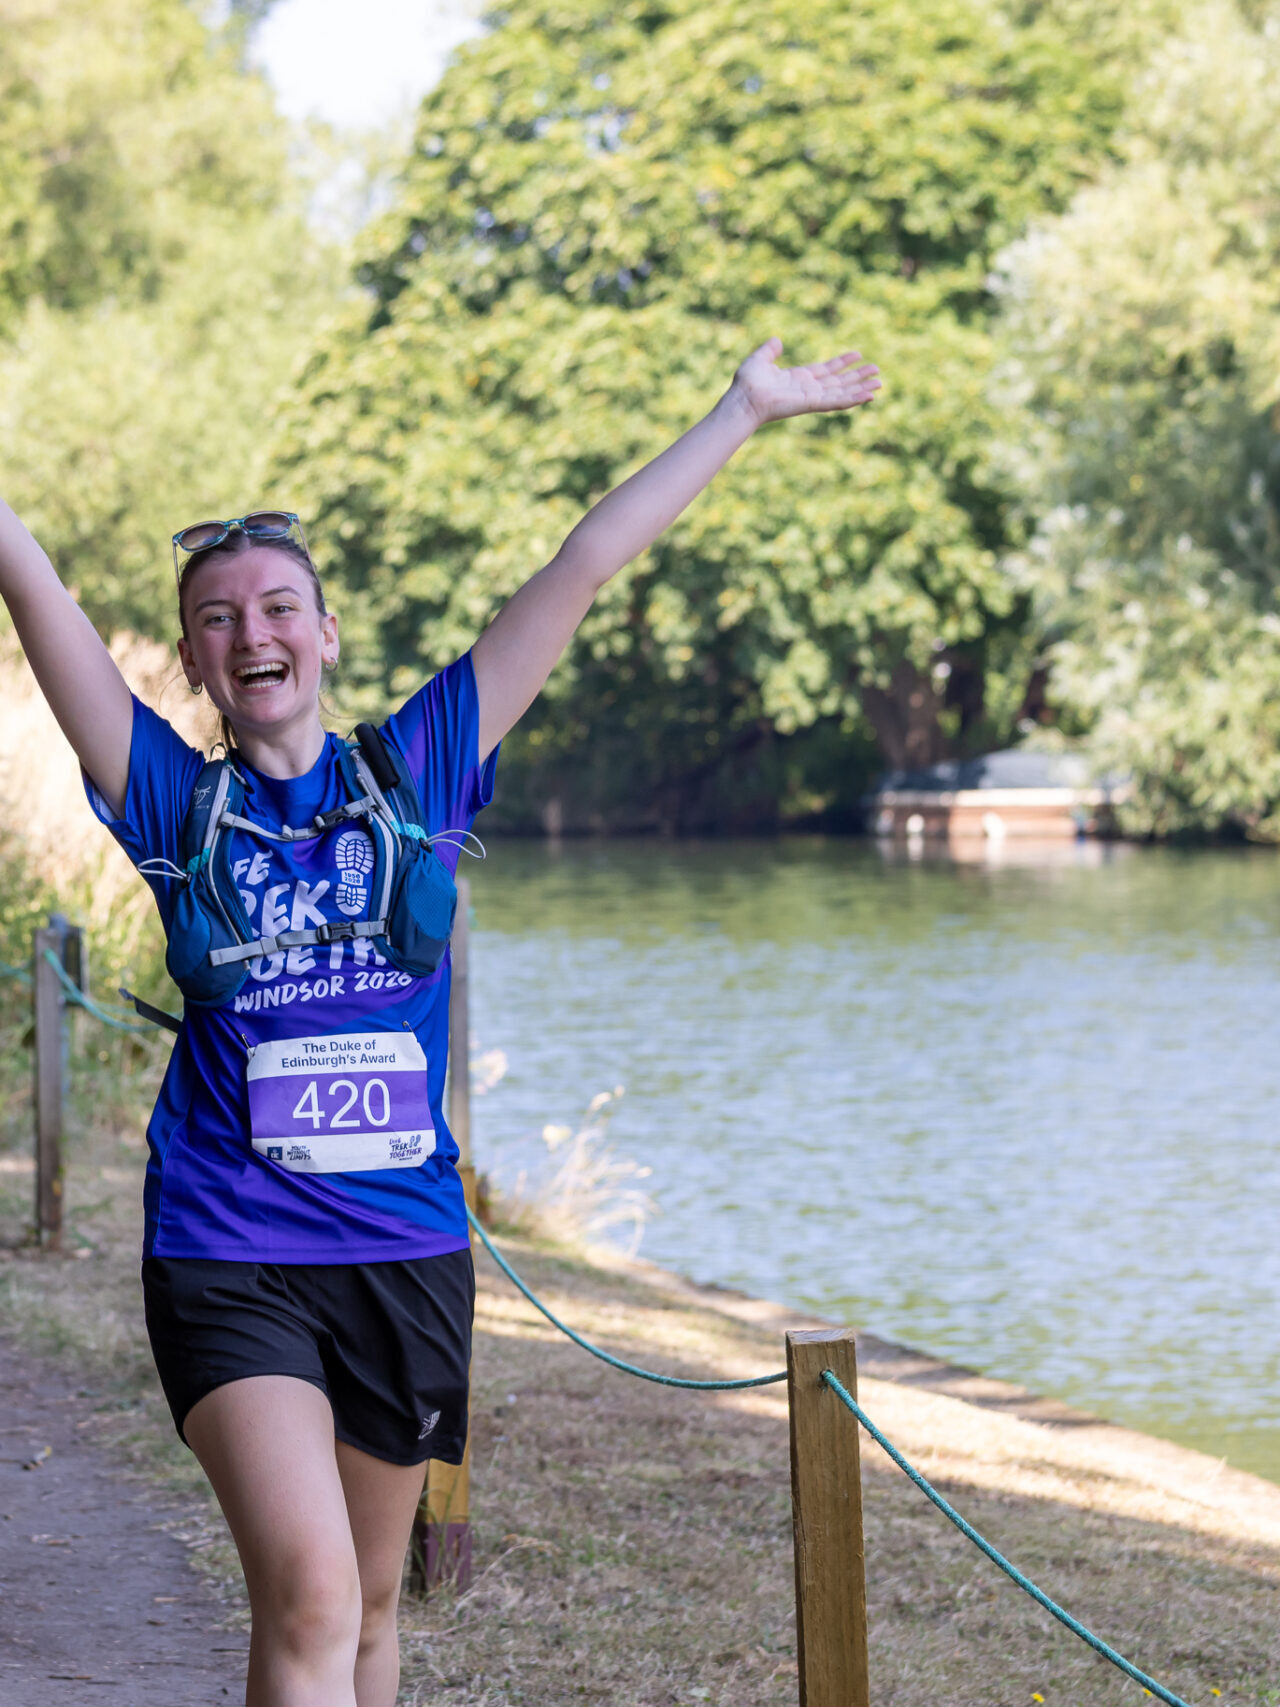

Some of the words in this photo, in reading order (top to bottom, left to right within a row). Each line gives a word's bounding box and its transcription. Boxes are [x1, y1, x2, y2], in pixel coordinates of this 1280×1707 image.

[234, 975, 346, 1013] WINDSOR
[354, 970, 413, 992] 2026
[302, 1042, 326, 1054] The
[330, 1041, 361, 1052] Duke
[364, 1039, 376, 1050] of
[281, 1053, 357, 1068] Edinburgh's
[360, 1053, 396, 1064] Award
[292, 1078, 391, 1129] 420
[392, 1142, 409, 1152] TREK
